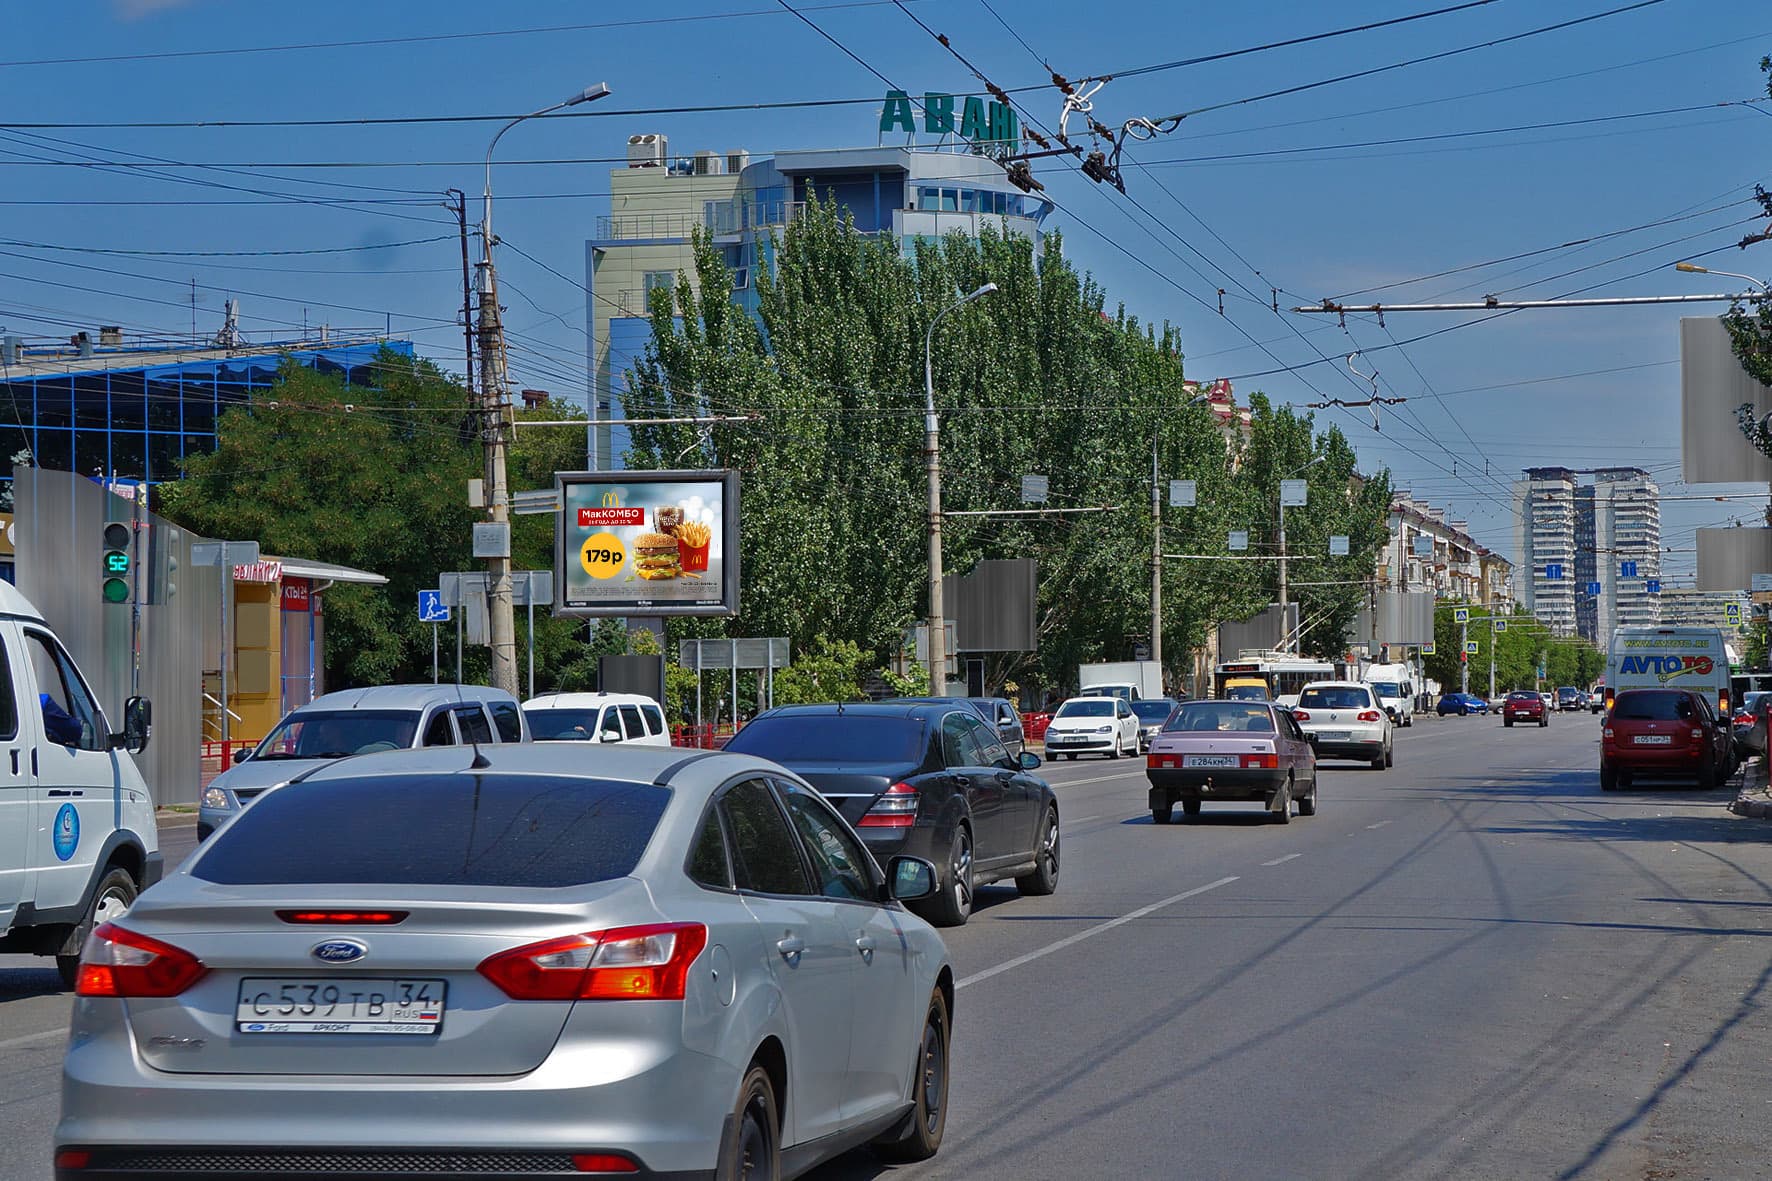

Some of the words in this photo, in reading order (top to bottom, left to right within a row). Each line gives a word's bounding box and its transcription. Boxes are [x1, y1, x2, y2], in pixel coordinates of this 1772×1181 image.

[582, 509, 639, 519] МакКОМБО
[108, 556, 128, 571] 52
[321, 944, 355, 958] Ford
[399, 983, 431, 1009] 34
[394, 1009, 419, 1019] RUS
